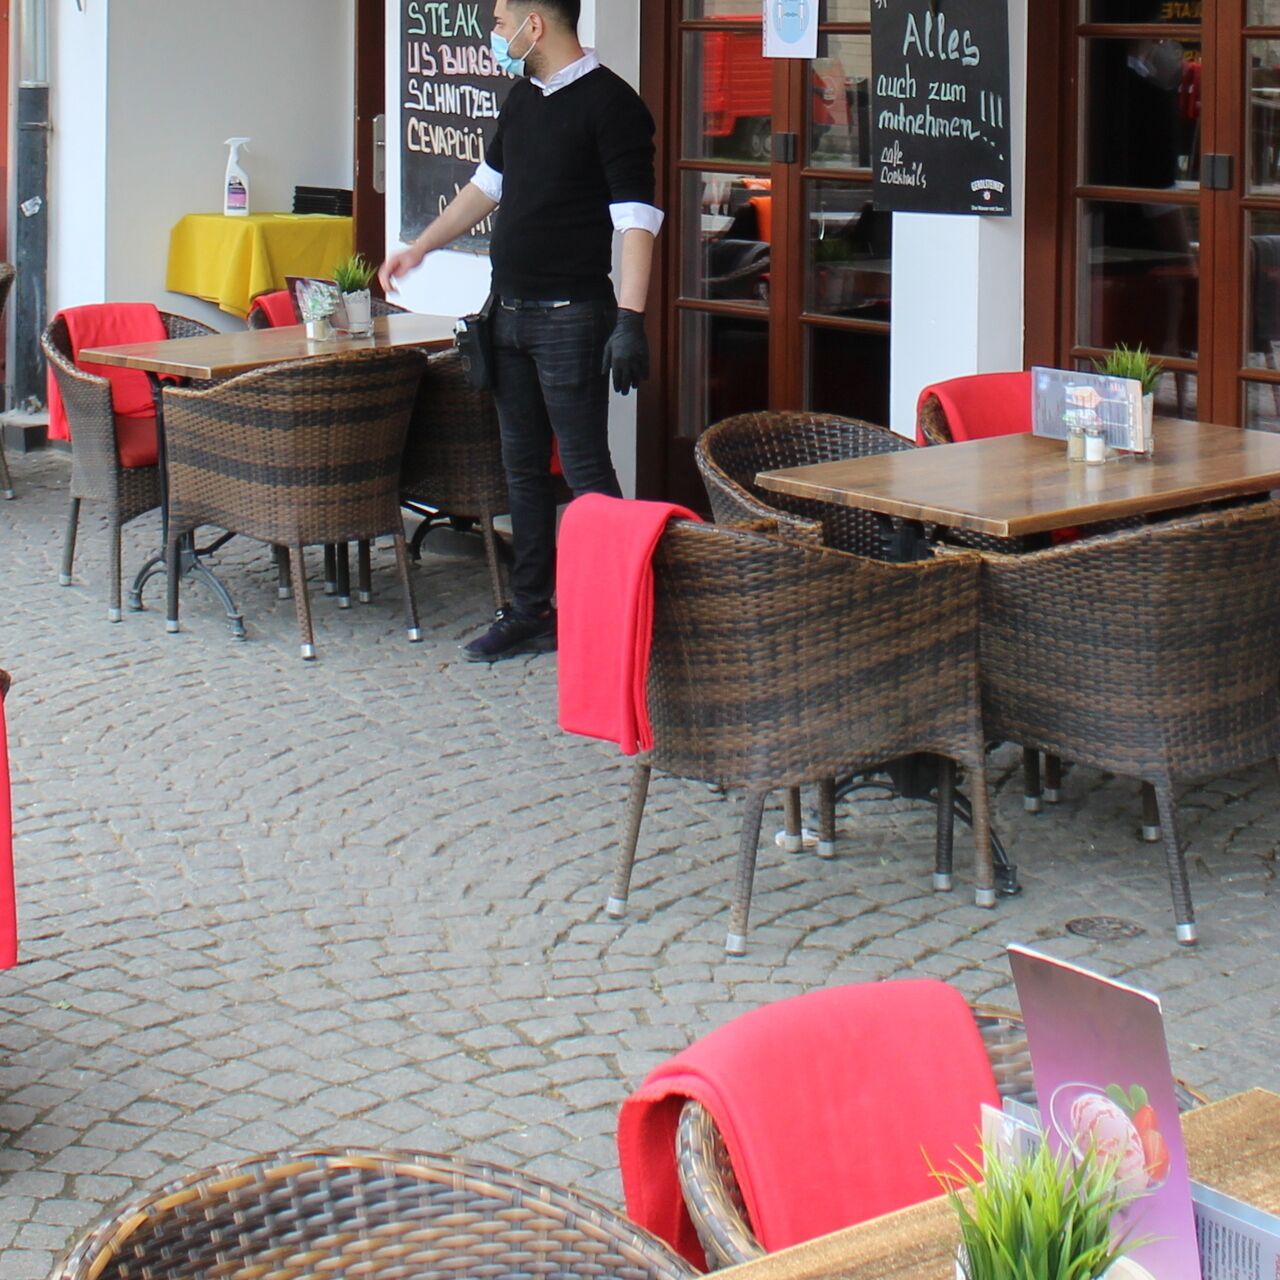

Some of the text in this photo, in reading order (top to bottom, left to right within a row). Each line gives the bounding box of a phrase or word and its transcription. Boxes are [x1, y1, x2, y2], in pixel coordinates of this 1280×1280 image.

[407, 1, 484, 40] STEAK
[903, 10, 981, 67] Alles
[404, 78, 501, 120] SCHNITZEL
[877, 63, 966, 103] auch zum
[878, 101, 980, 141] mitnehmen
